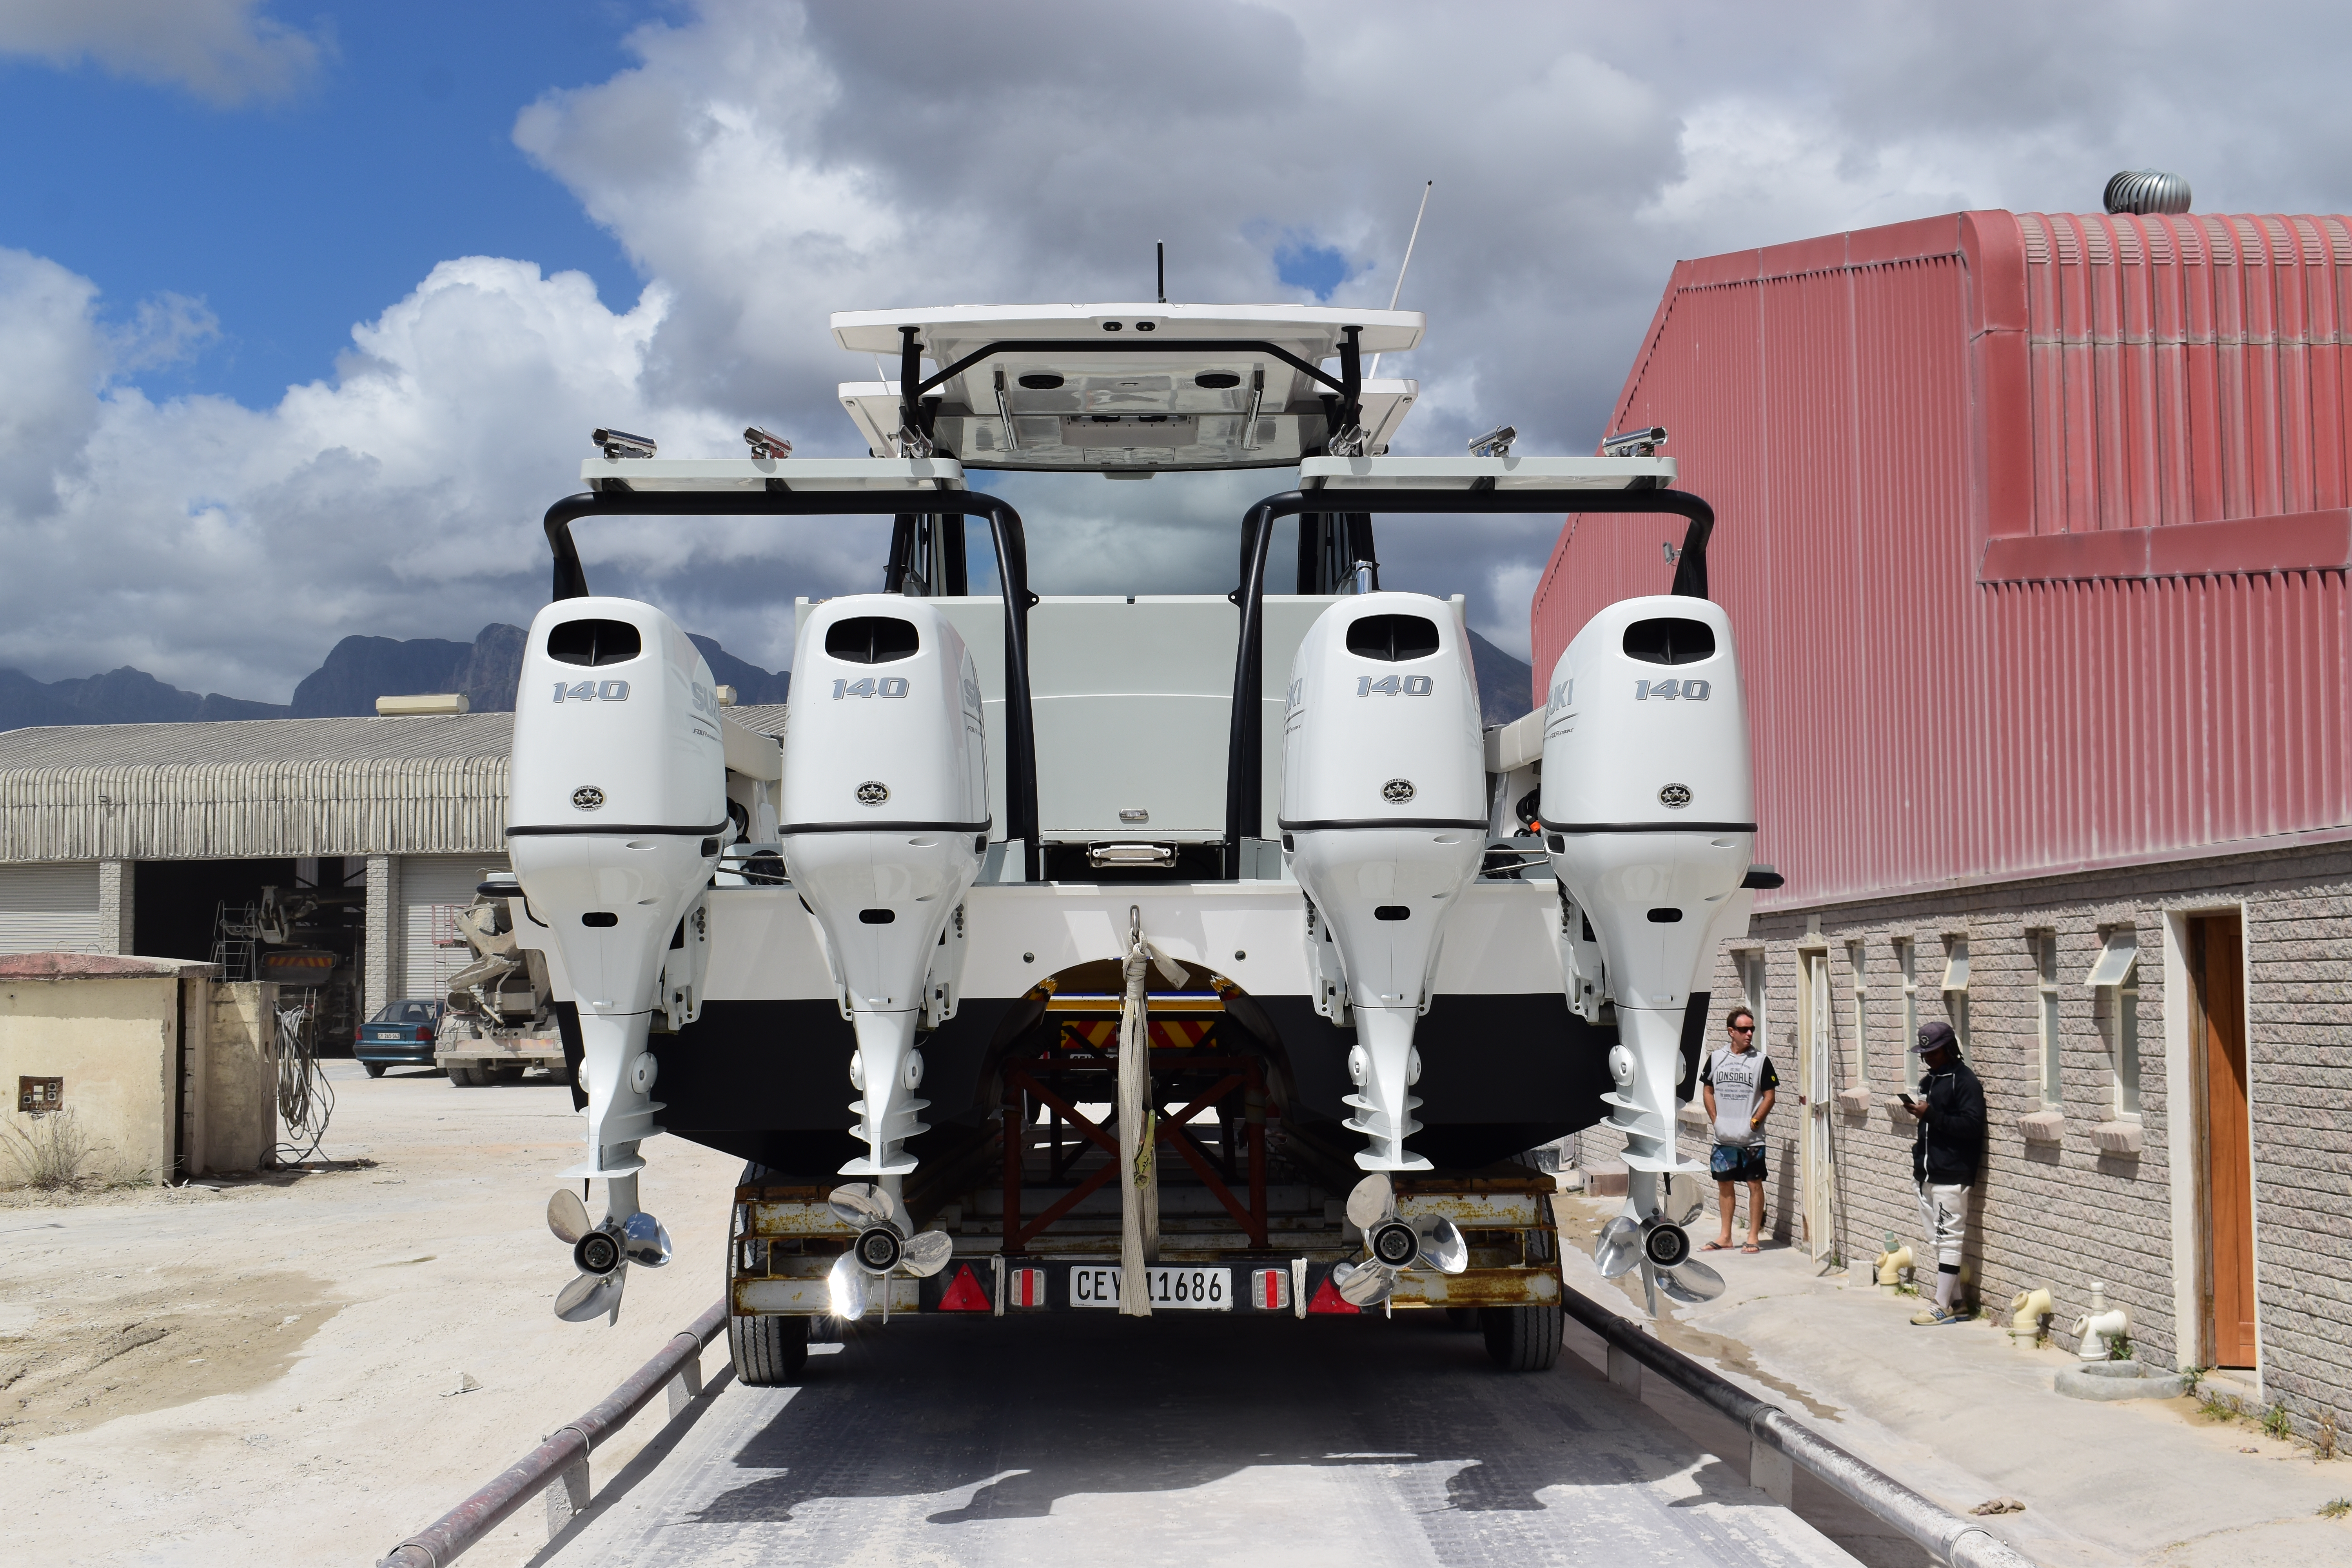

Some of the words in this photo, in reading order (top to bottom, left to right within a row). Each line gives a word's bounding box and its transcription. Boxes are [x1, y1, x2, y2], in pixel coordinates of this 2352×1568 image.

[553, 680, 631, 704] 140
[832, 677, 910, 700] 140
[1356, 675, 1434, 697] 140
[1635, 679, 1711, 701] 140
[1717, 1071, 1753, 1084] LONSDALE
[1146, 1272, 1222, 1302] 11686
